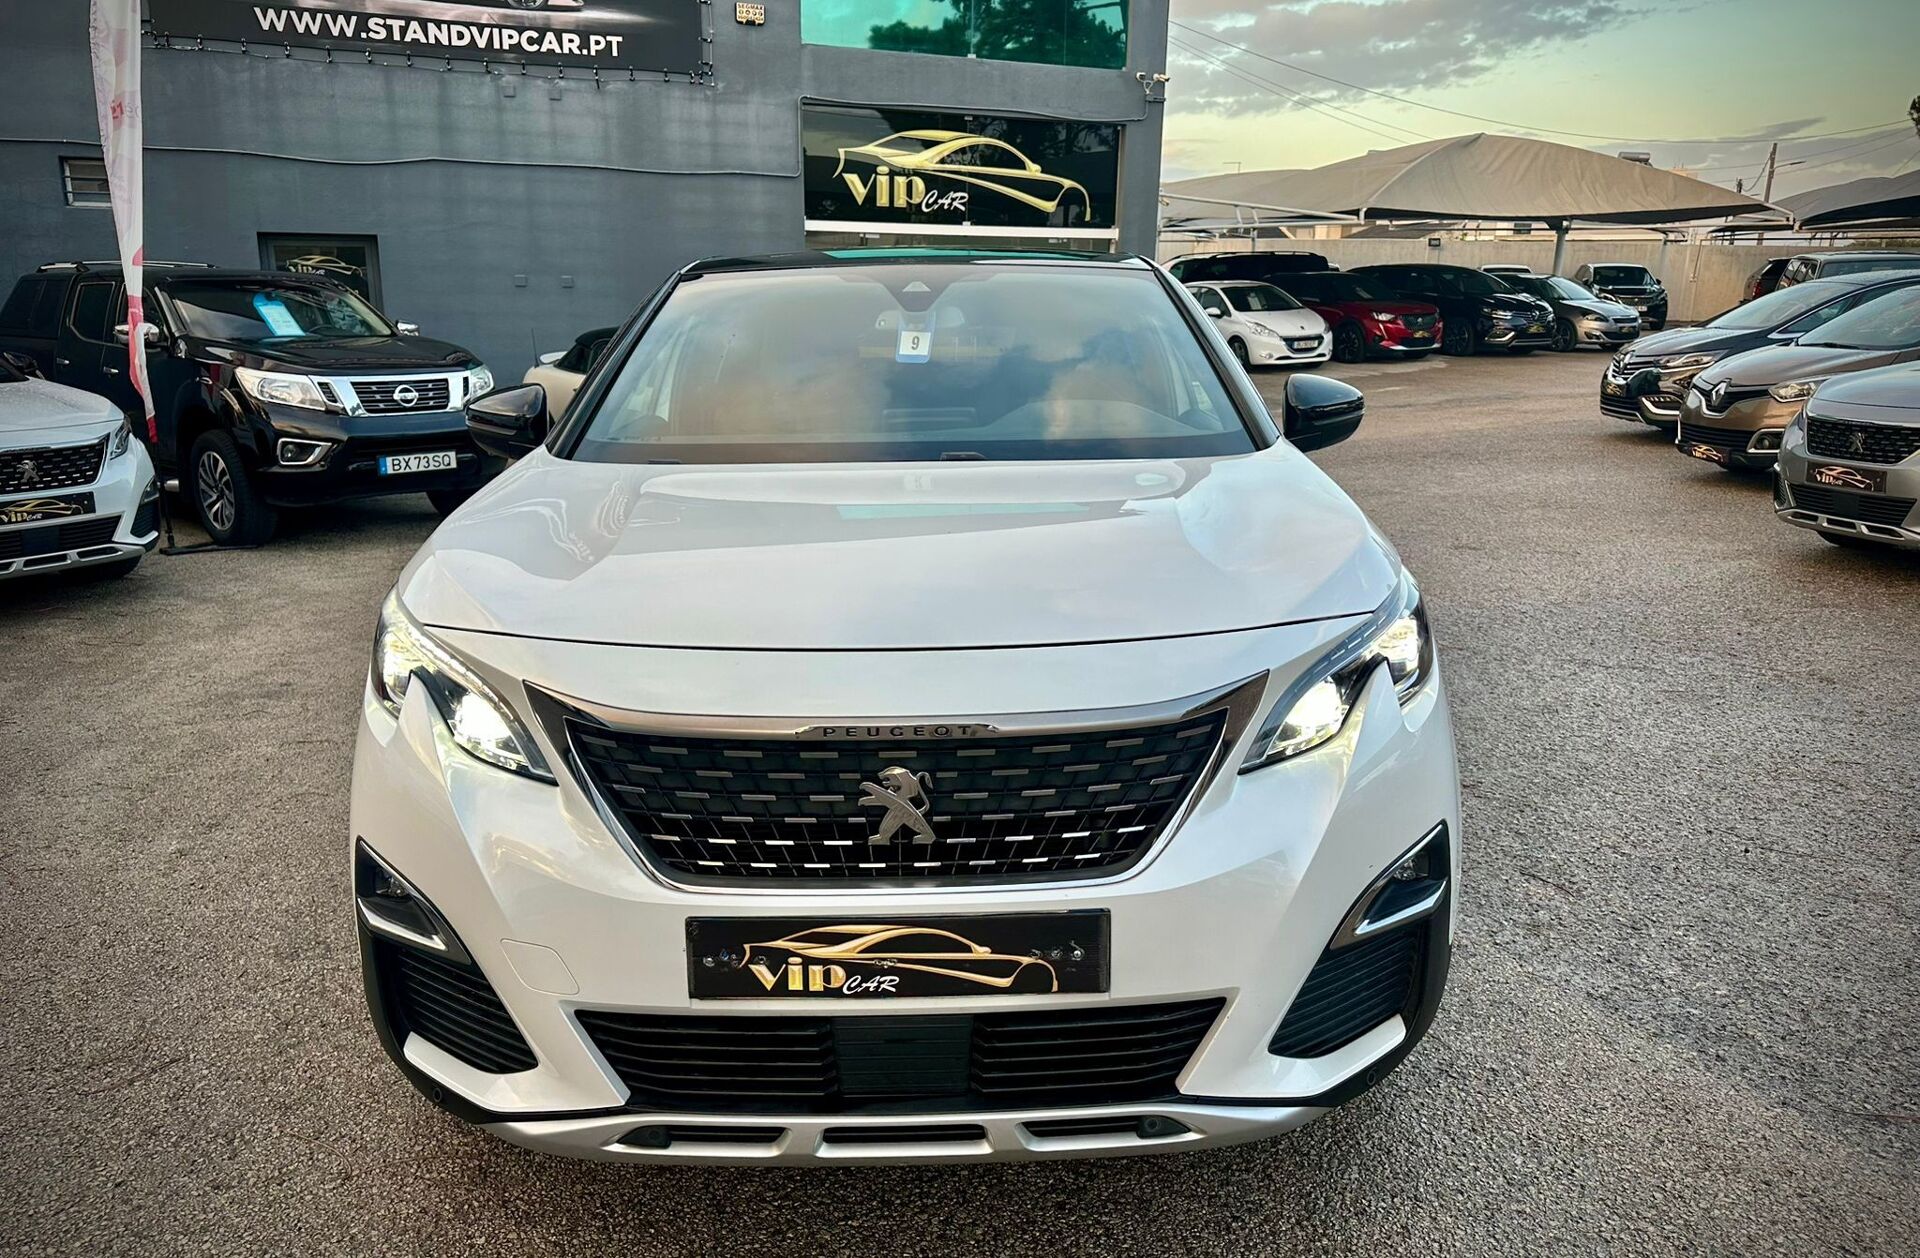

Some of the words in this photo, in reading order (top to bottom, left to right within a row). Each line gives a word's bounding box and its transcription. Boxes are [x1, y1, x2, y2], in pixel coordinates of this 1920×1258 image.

[254, 7, 623, 57] WWW.STANDVIPCAR.PT
[842, 166, 926, 208] vip
[921, 190, 969, 213] CAR
[911, 336, 920, 350] 9
[391, 454, 452, 472] BX73SQ
[822, 725, 971, 737] PEUGEOT
[748, 956, 847, 992] vip
[843, 975, 900, 995] CAR
